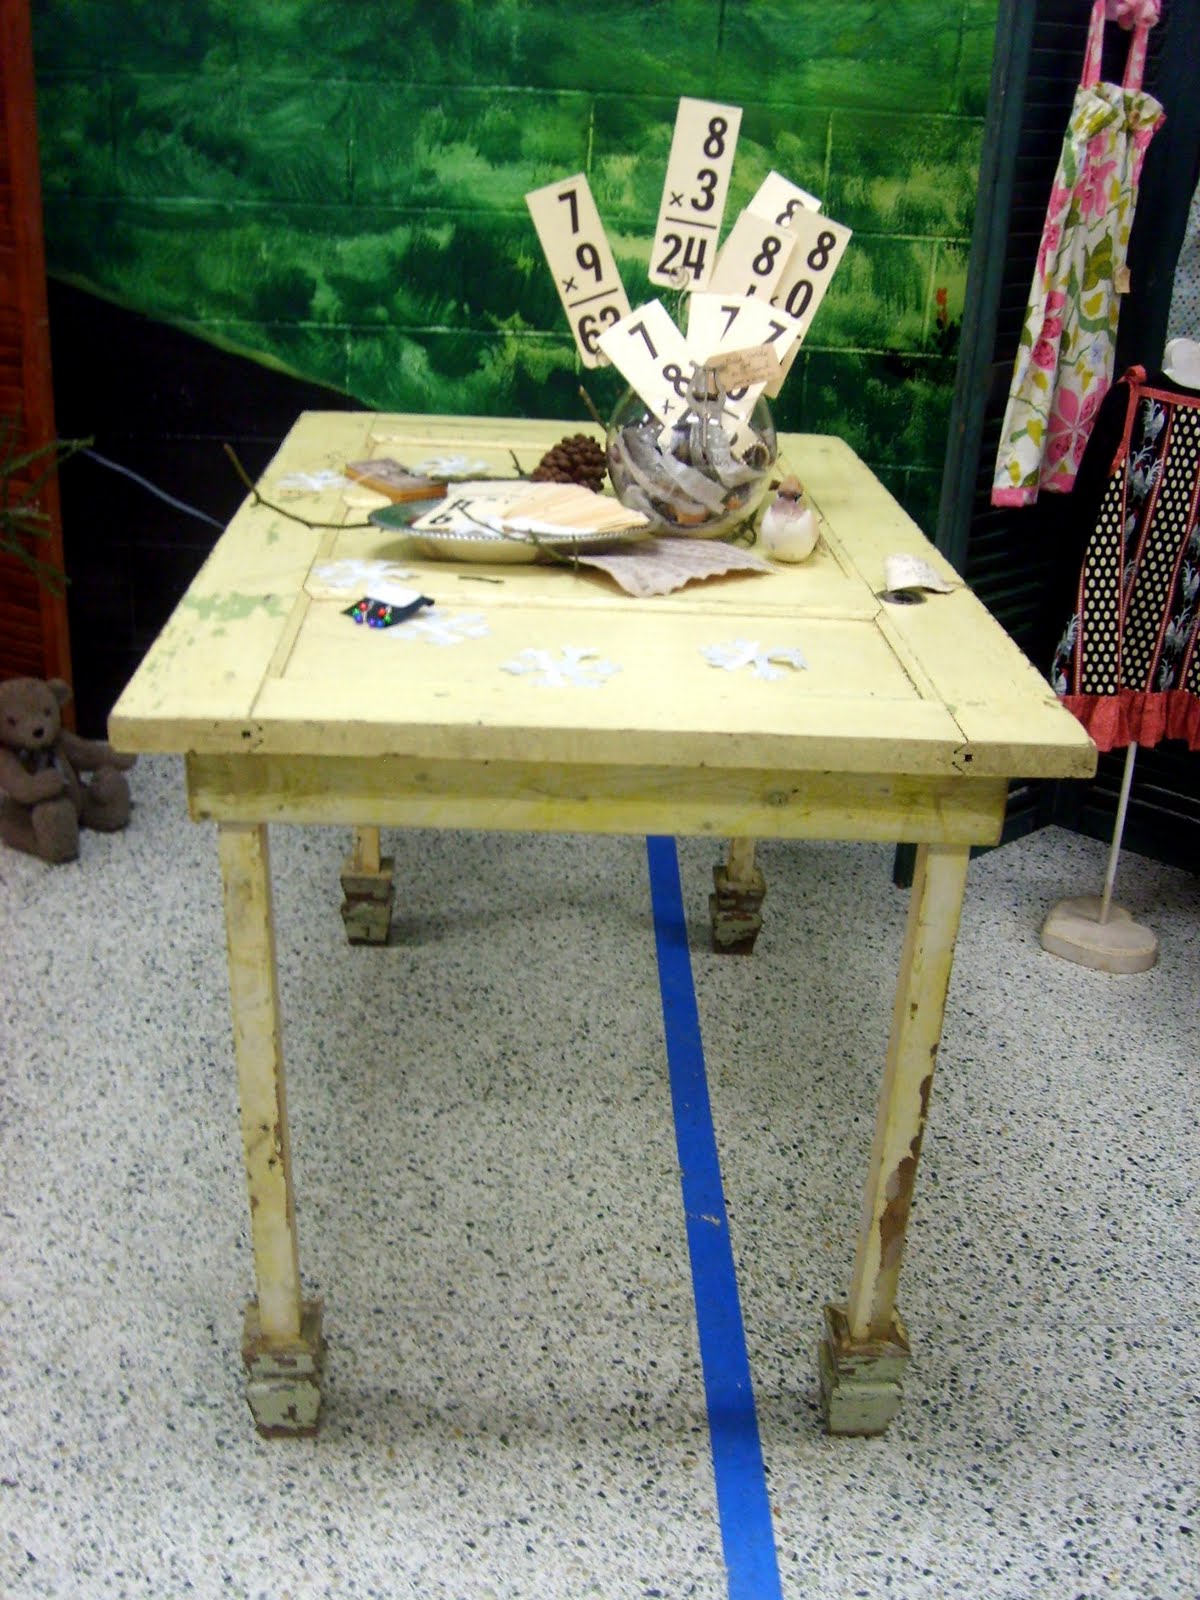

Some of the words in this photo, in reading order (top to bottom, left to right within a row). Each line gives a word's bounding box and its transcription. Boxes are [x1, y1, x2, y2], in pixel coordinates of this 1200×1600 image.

[704, 117, 727, 159] 8
[691, 168, 718, 212] 3
[558, 189, 579, 234] 7
[576, 243, 602, 283] 9
[656, 234, 707, 280] 24
[752, 236, 782, 276] 8
[807, 231, 836, 271] 8
[785, 279, 813, 319] 0
[628, 321, 659, 360] 7
[721, 305, 741, 342] 7
[764, 319, 787, 344] 7
